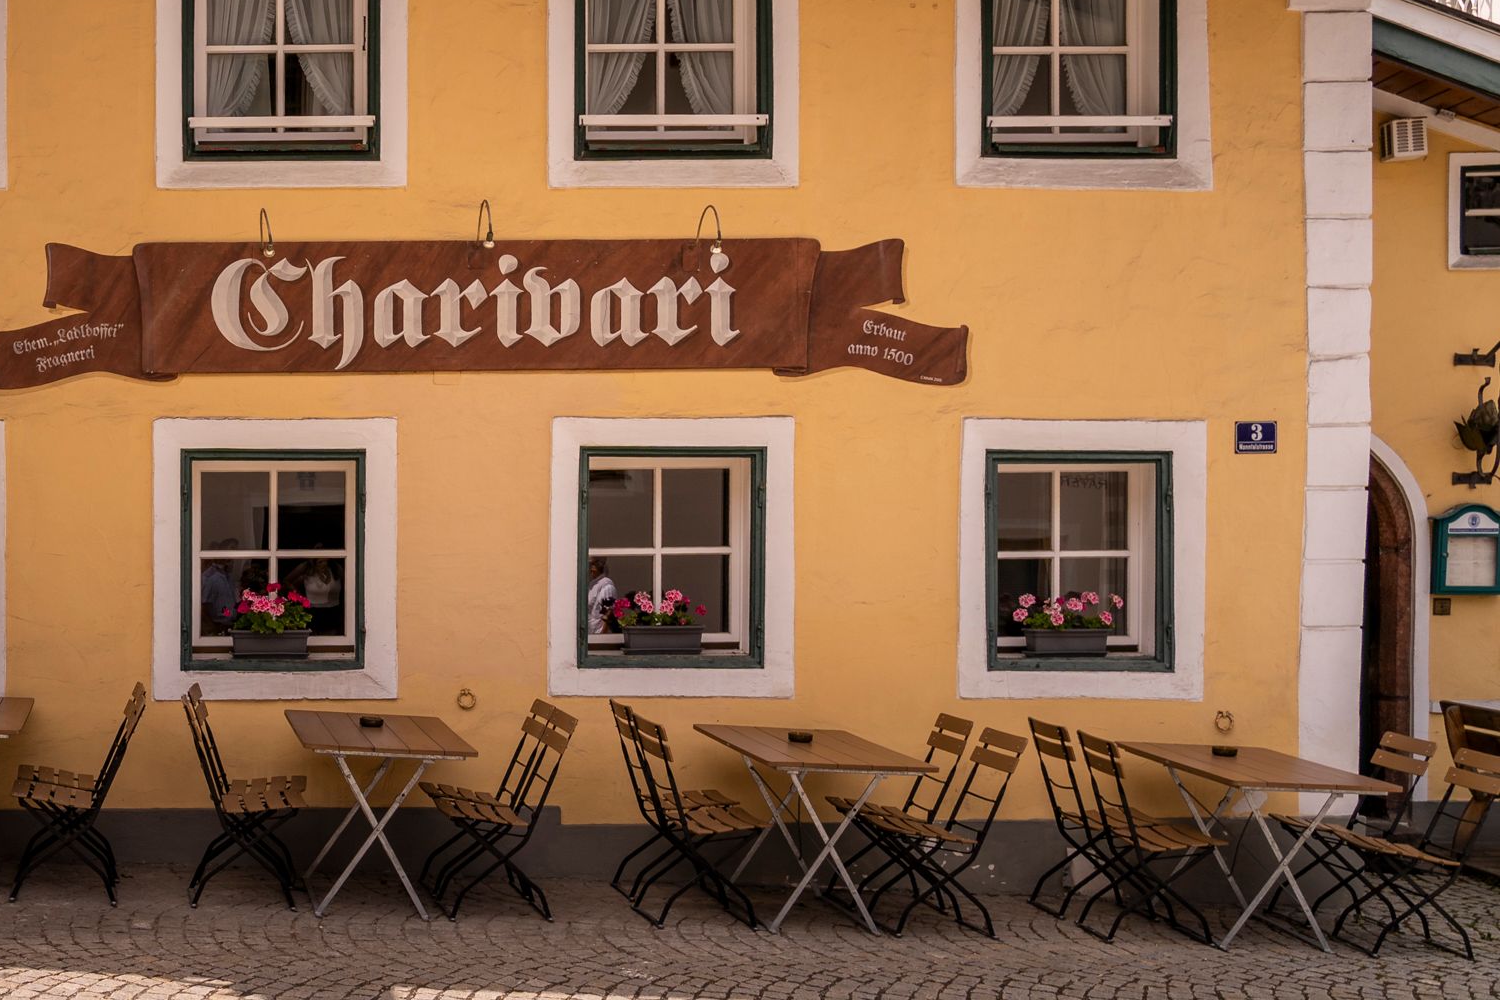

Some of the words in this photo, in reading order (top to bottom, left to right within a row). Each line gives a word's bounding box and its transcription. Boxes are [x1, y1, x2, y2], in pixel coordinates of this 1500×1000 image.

[211, 254, 741, 370] Charivari
[862, 319, 907, 342] Erbaut
[13, 337, 52, 355] Ehem.
[847, 343, 879, 357] anno
[883, 347, 914, 366] 1500
[36, 345, 95, 373] Fragnerei
[1251, 423, 1263, 441] 3
